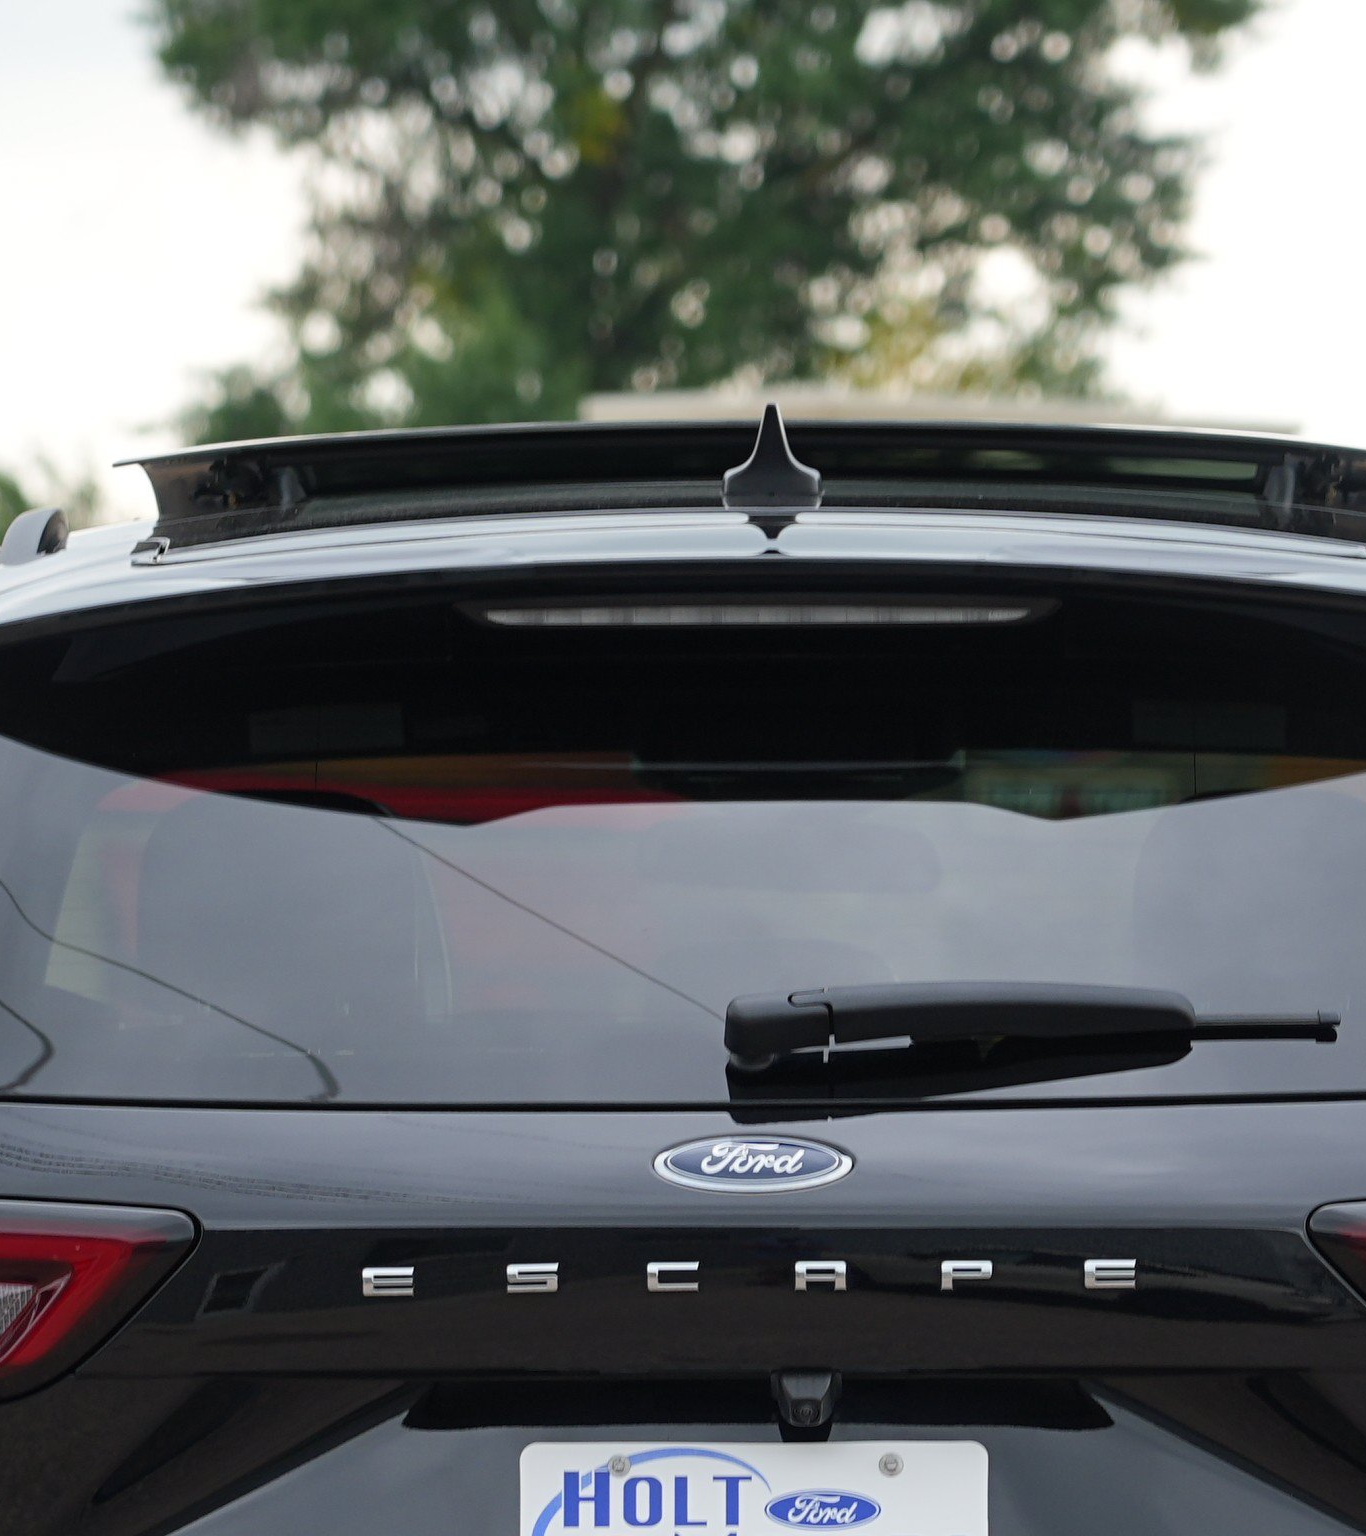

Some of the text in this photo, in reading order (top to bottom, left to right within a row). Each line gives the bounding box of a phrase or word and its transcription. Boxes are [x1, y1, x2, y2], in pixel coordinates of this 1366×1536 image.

[700, 1141, 805, 1174] Ford
[362, 1258, 1137, 1297] ESCAPE
[563, 1471, 752, 1527] HOLT
[787, 1494, 858, 1525] Ford
